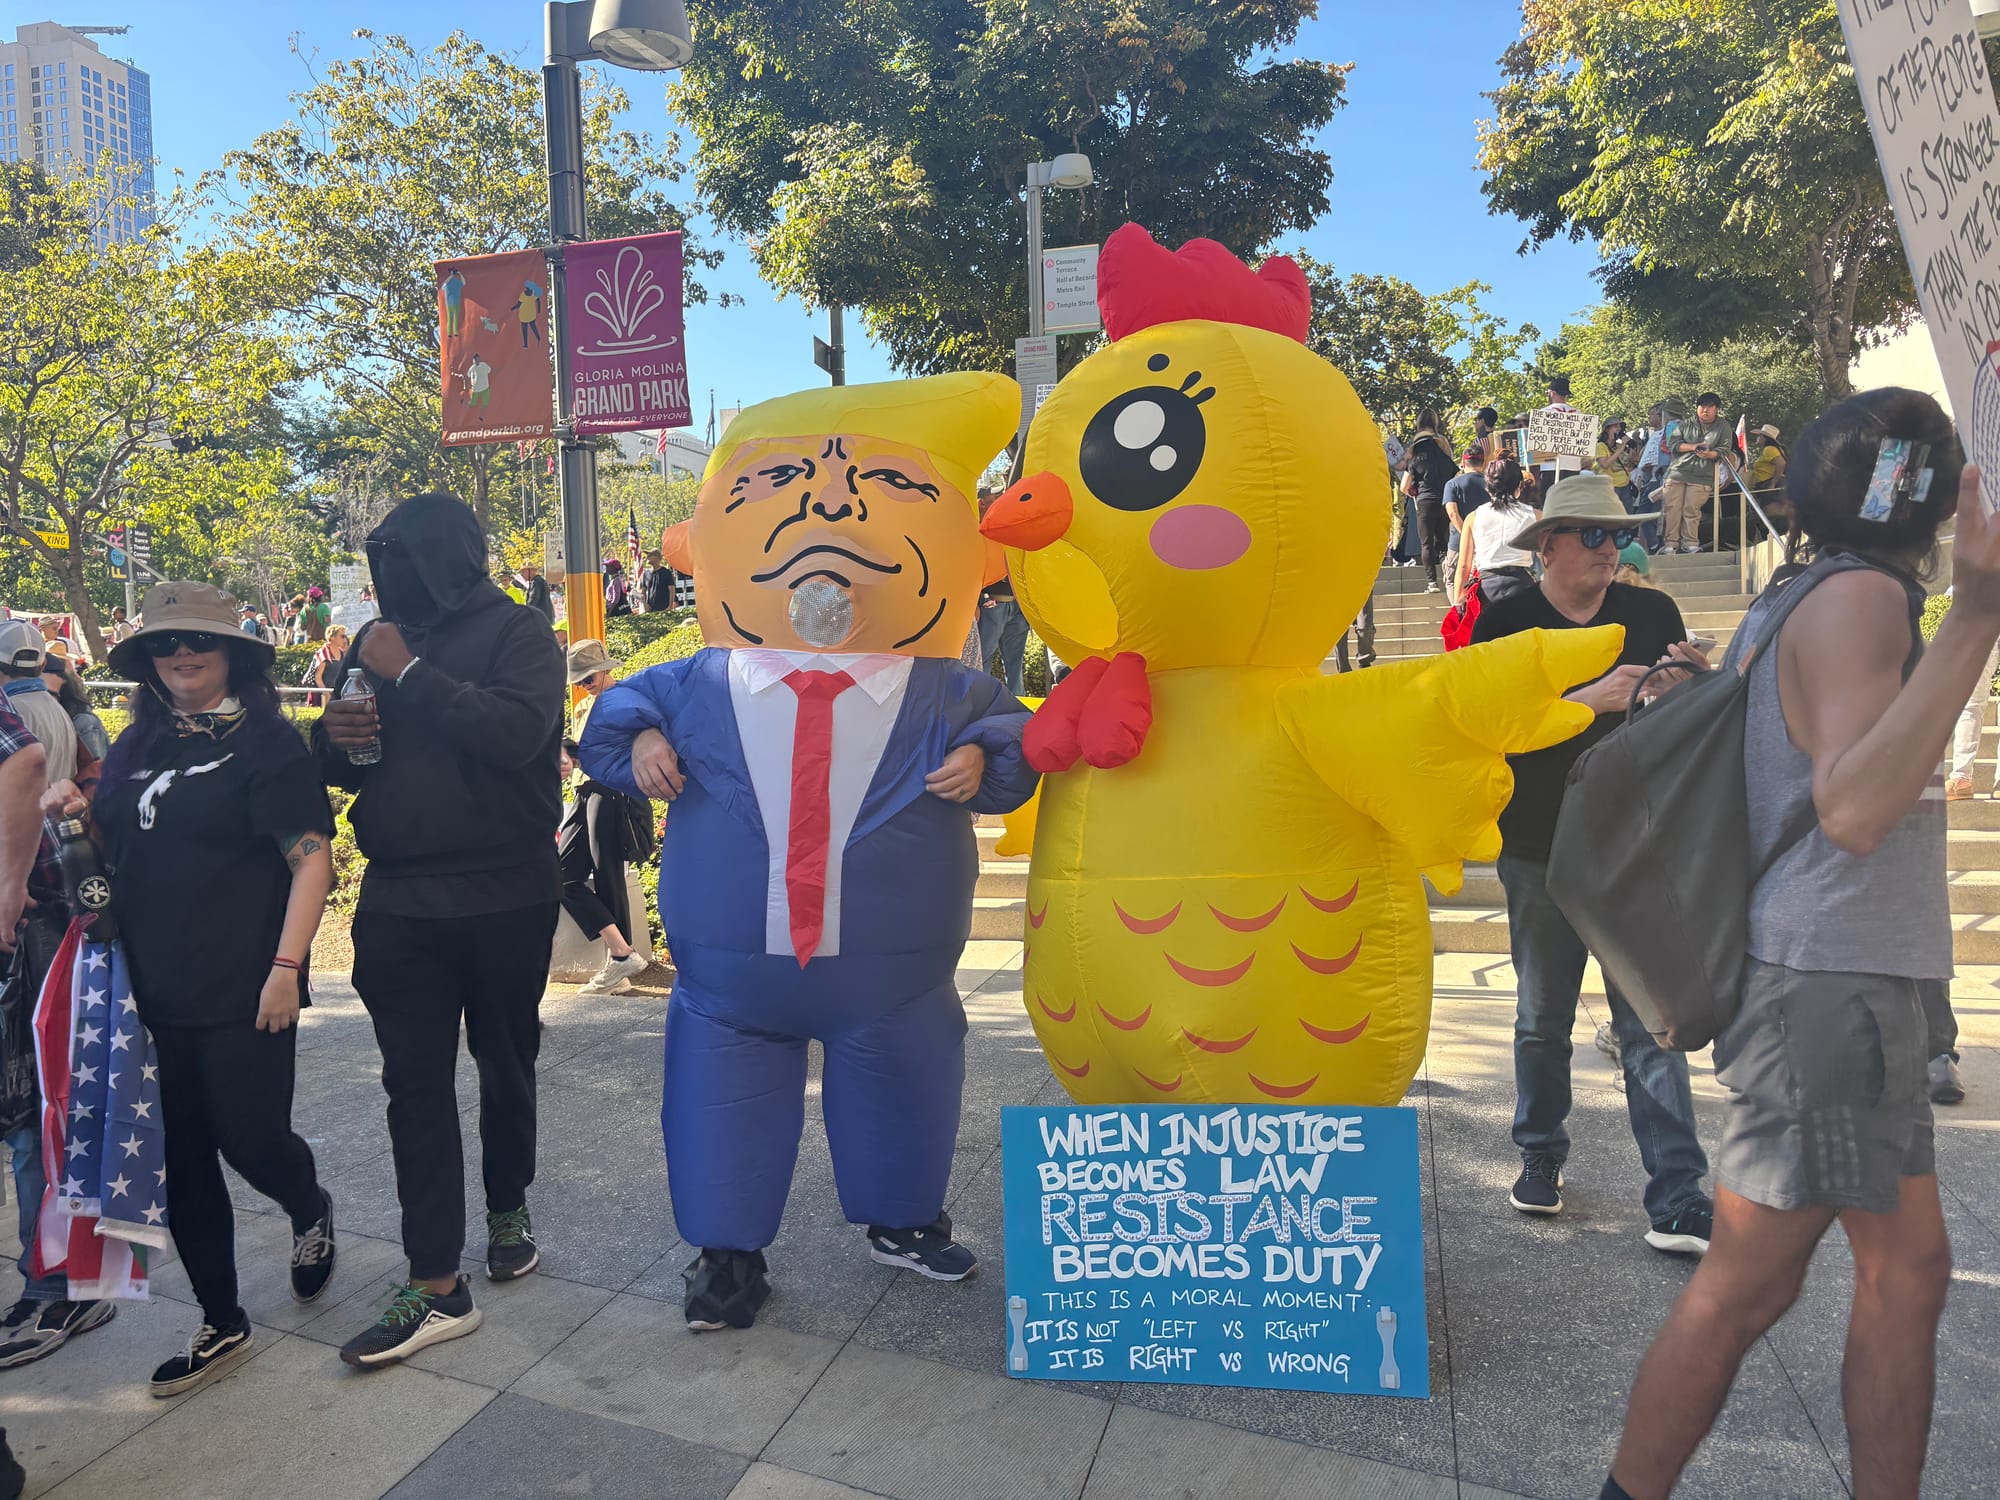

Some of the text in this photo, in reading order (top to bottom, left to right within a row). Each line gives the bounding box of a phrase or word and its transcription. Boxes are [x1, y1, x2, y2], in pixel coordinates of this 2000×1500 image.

[1877, 29, 1984, 135] OF THE PEOPLE
[1900, 166, 1927, 224] IS
[1921, 113, 2000, 220] STRONGER
[1056, 258, 1086, 266] Community
[1923, 229, 1968, 333] THAN
[1960, 196, 1992, 264] THE
[1959, 296, 1983, 367] IN
[574, 361, 684, 383] GLORIA MOLINA
[575, 377, 689, 416] GRAND PARK
[618, 415, 637, 424] FOR
[640, 411, 689, 423] EVERYONE
[1531, 417, 1590, 431] BE DESTROYED BY
[1532, 410, 1544, 418] THE
[1545, 411, 1564, 420] WORLD
[1581, 415, 1594, 423] NOT
[450, 424, 544, 442] grandparkla.org
[1529, 433, 1590, 446] GOOD PEOPLE WHO
[1530, 425, 1593, 439] EVIL PEOPLE BUT BY
[1534, 440, 1589, 456] DO NOTHING
[46, 535, 67, 546] XING
[1039, 1107, 1365, 1157] WHEN INJUSTICE
[1036, 1153, 1329, 1194] BECOMES LAW
[1040, 1190, 1381, 1245] RESISTANCE
[1052, 1242, 1383, 1291] BECOMES DUTY
[1042, 1288, 1372, 1312] THIS IS A MORAL MOMENT:
[1025, 1318, 1331, 1343] IT IS NOT "LEFT VS RIGHT"
[1049, 1343, 1352, 1384] IT IS RIGHT VS WRONG
